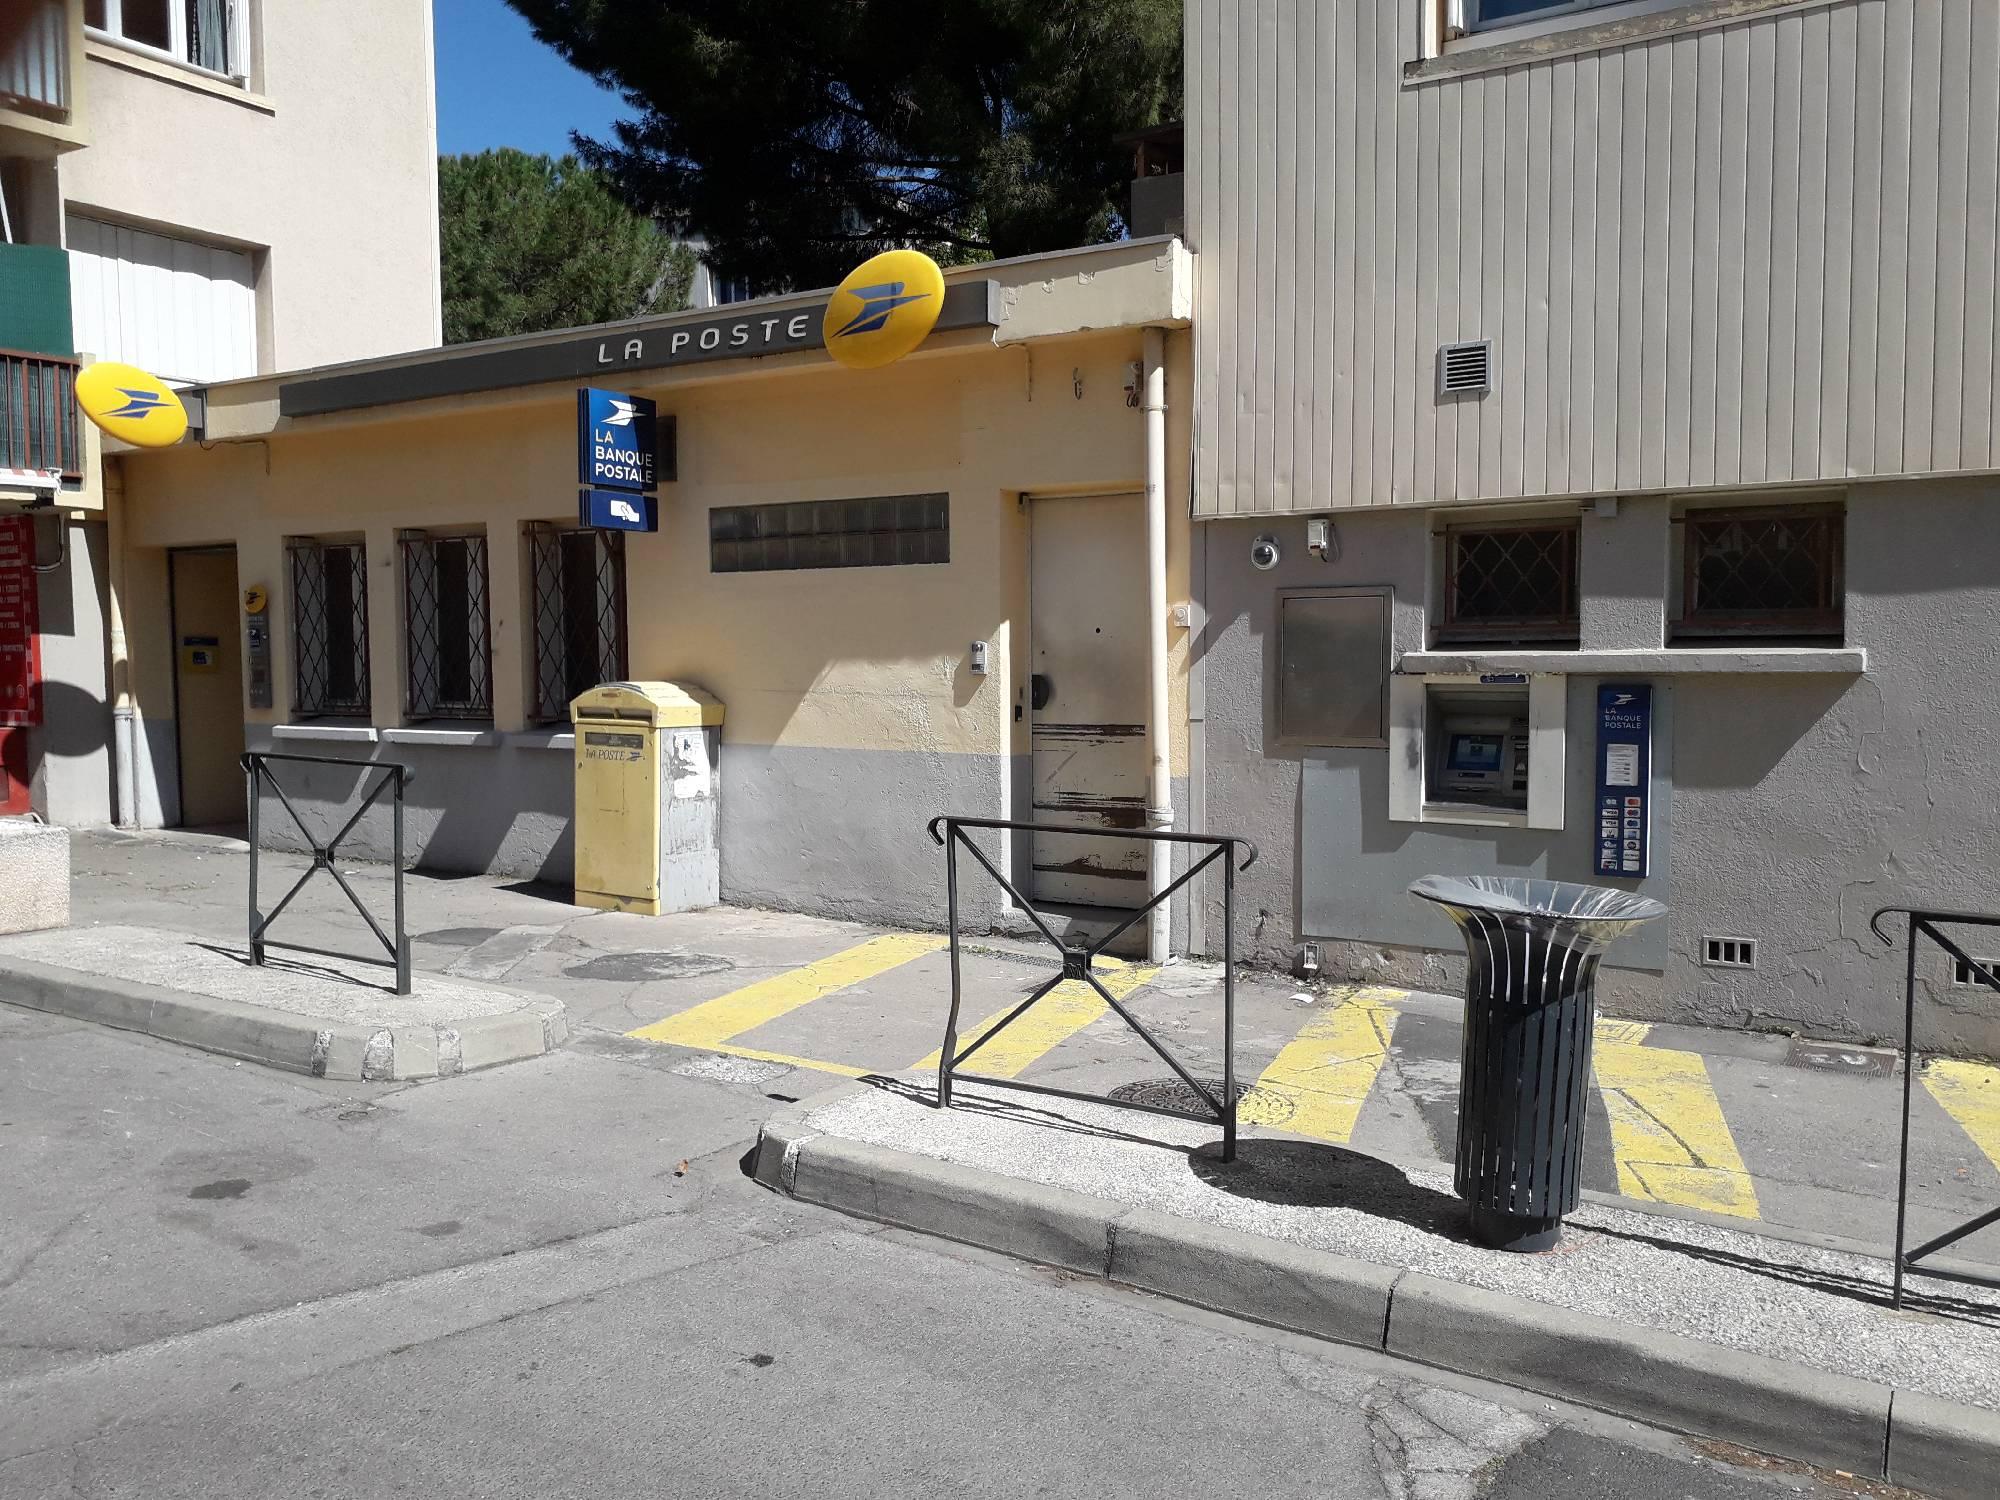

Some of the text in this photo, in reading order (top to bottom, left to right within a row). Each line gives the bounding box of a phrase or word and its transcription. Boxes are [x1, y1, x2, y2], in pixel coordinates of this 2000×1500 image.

[598, 315, 809, 363] LA POSTE
[595, 428, 614, 444] LA
[595, 445, 653, 467] BANQUE
[595, 462, 653, 484] POSTALE
[1604, 714, 1642, 722] BANQUE
[598, 749, 625, 760] POSTE
